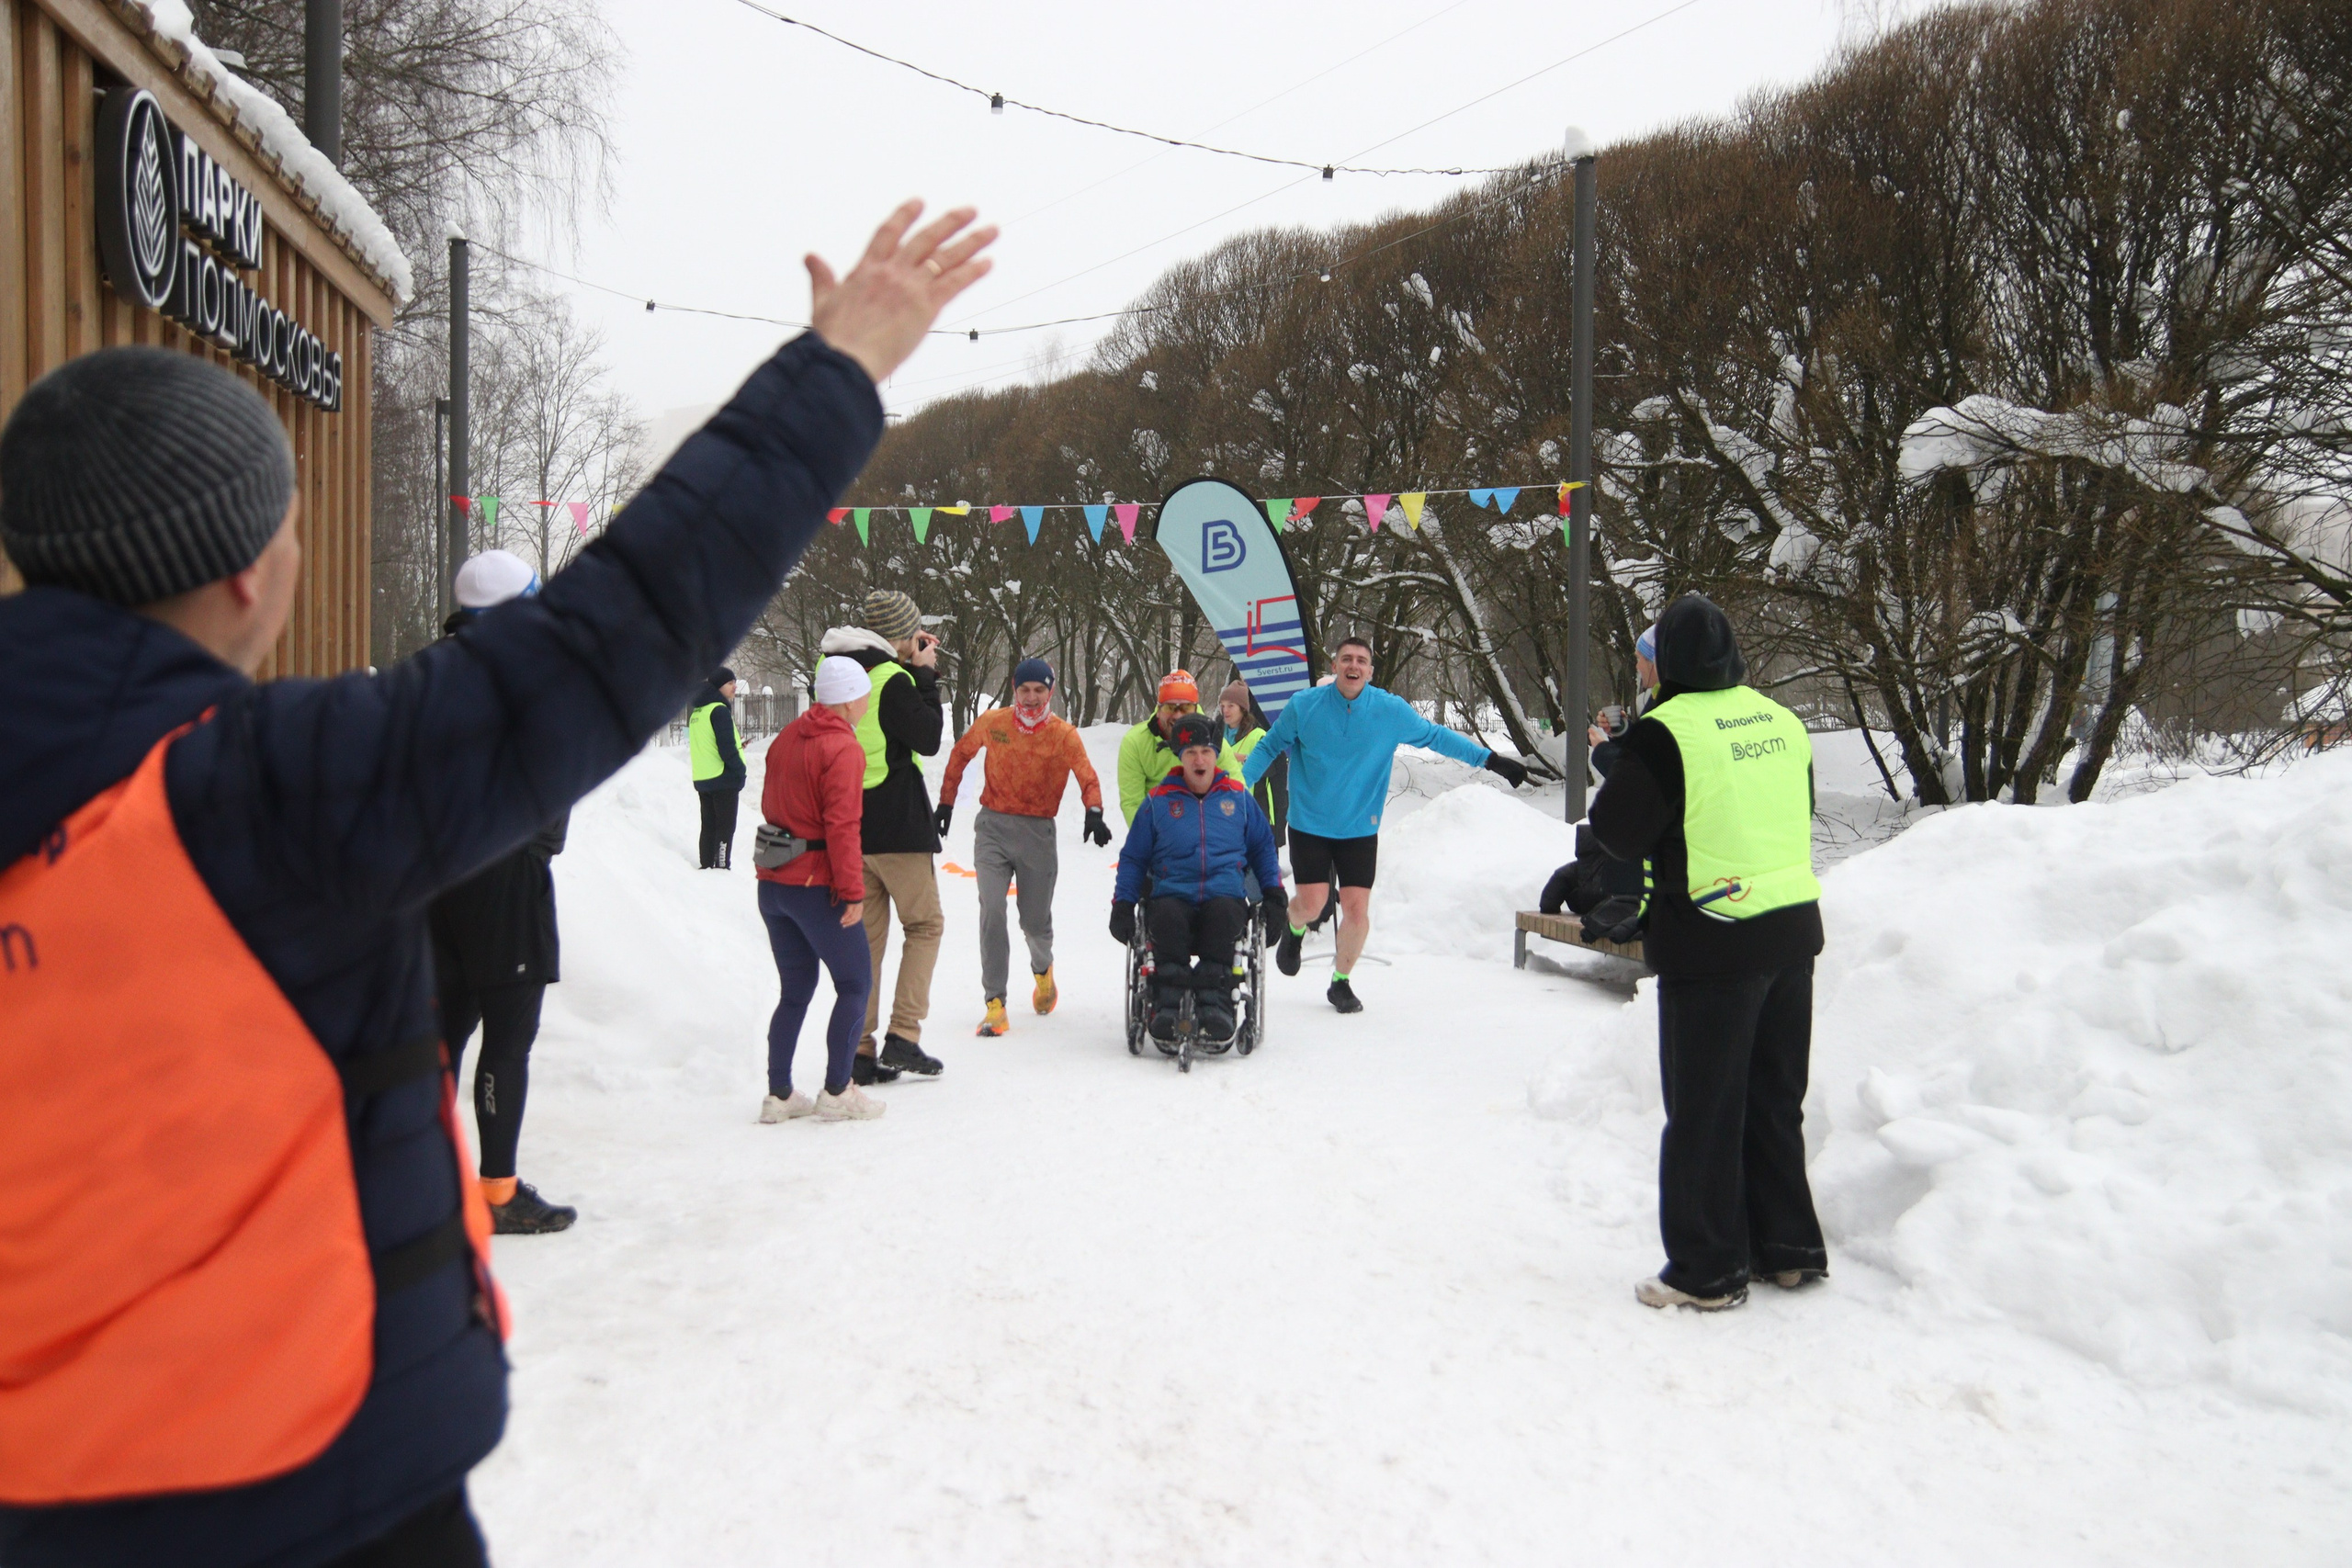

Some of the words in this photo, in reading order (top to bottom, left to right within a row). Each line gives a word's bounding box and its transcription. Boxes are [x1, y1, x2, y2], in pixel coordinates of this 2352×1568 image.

[183, 134, 263, 270] ПАРКИ
[184, 238, 341, 412] ПОДМОСКОВЬЯ
[1257, 666, 1294, 677] 5verst.ru
[1714, 711, 1774, 730] Волонтёр
[484, 1072, 497, 1114] 2XU
